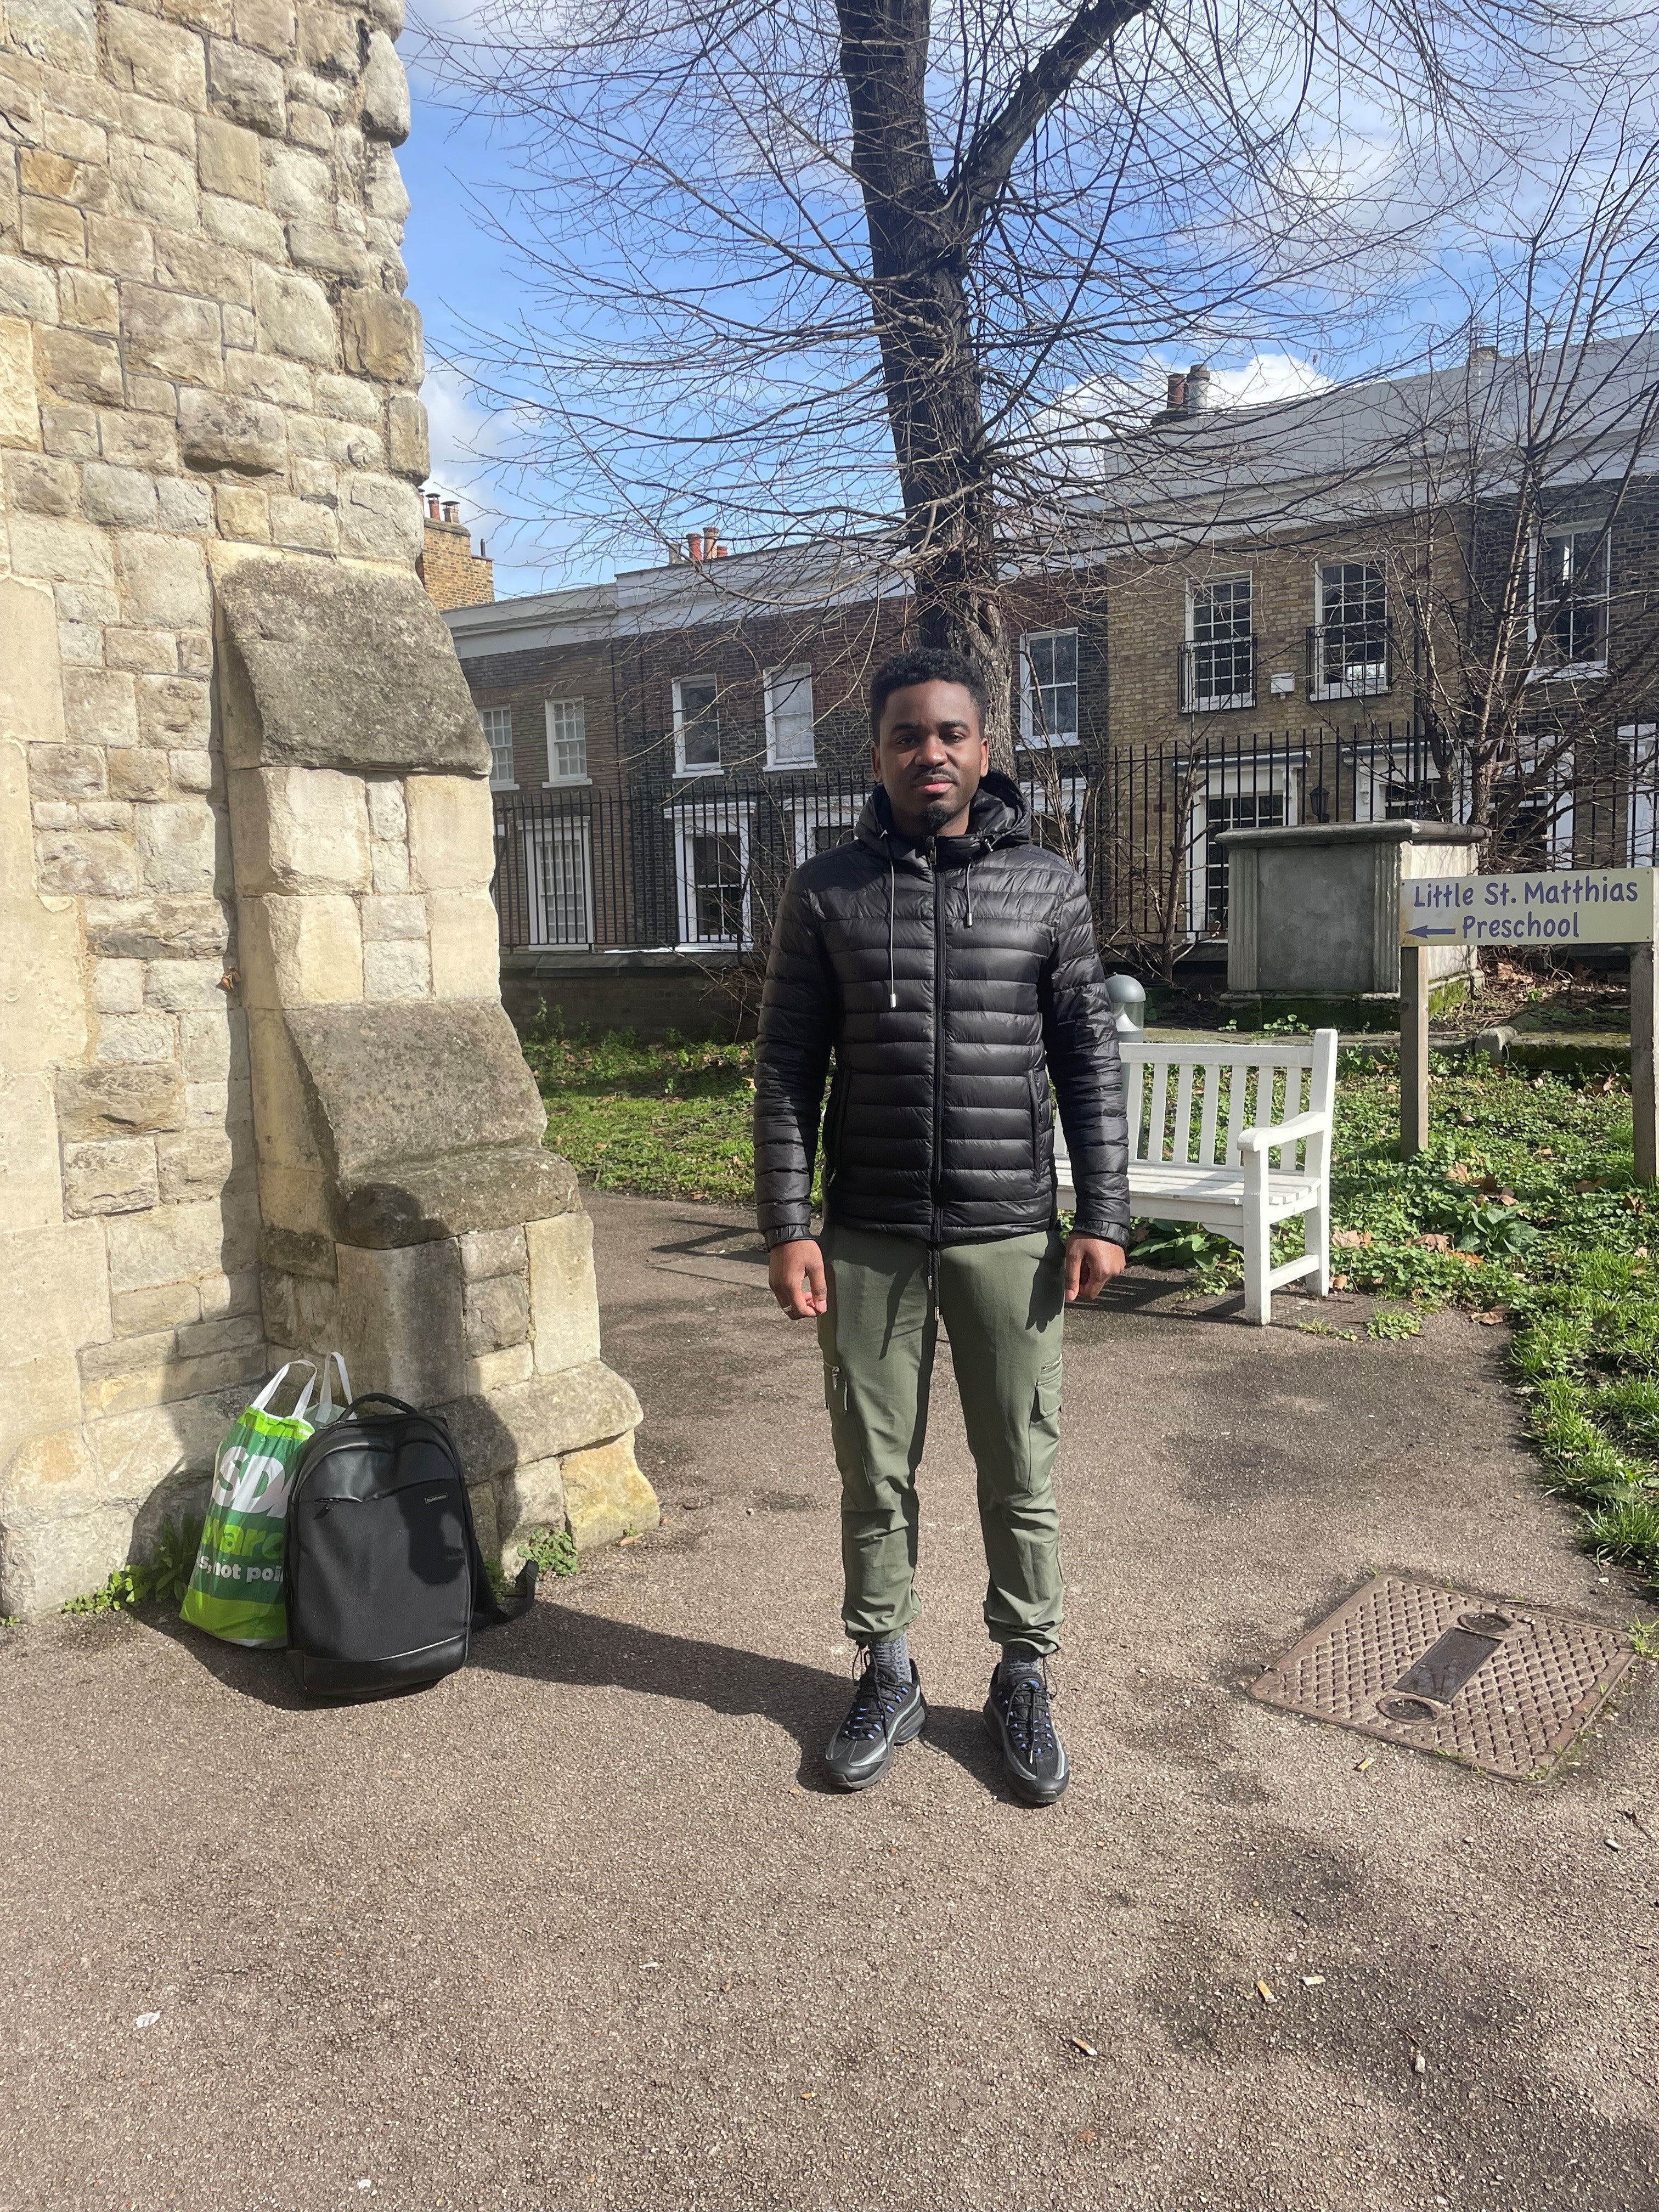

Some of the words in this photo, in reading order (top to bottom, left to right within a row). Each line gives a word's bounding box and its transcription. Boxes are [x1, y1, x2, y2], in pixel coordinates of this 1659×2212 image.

[1414, 883, 1474, 908] Little
[1485, 882, 1516, 906] St.
[1525, 875, 1638, 904] Matthias
[1462, 911, 1579, 939] Preschool
[213, 1561, 241, 1579] not
[246, 1565, 284, 1583] poi
